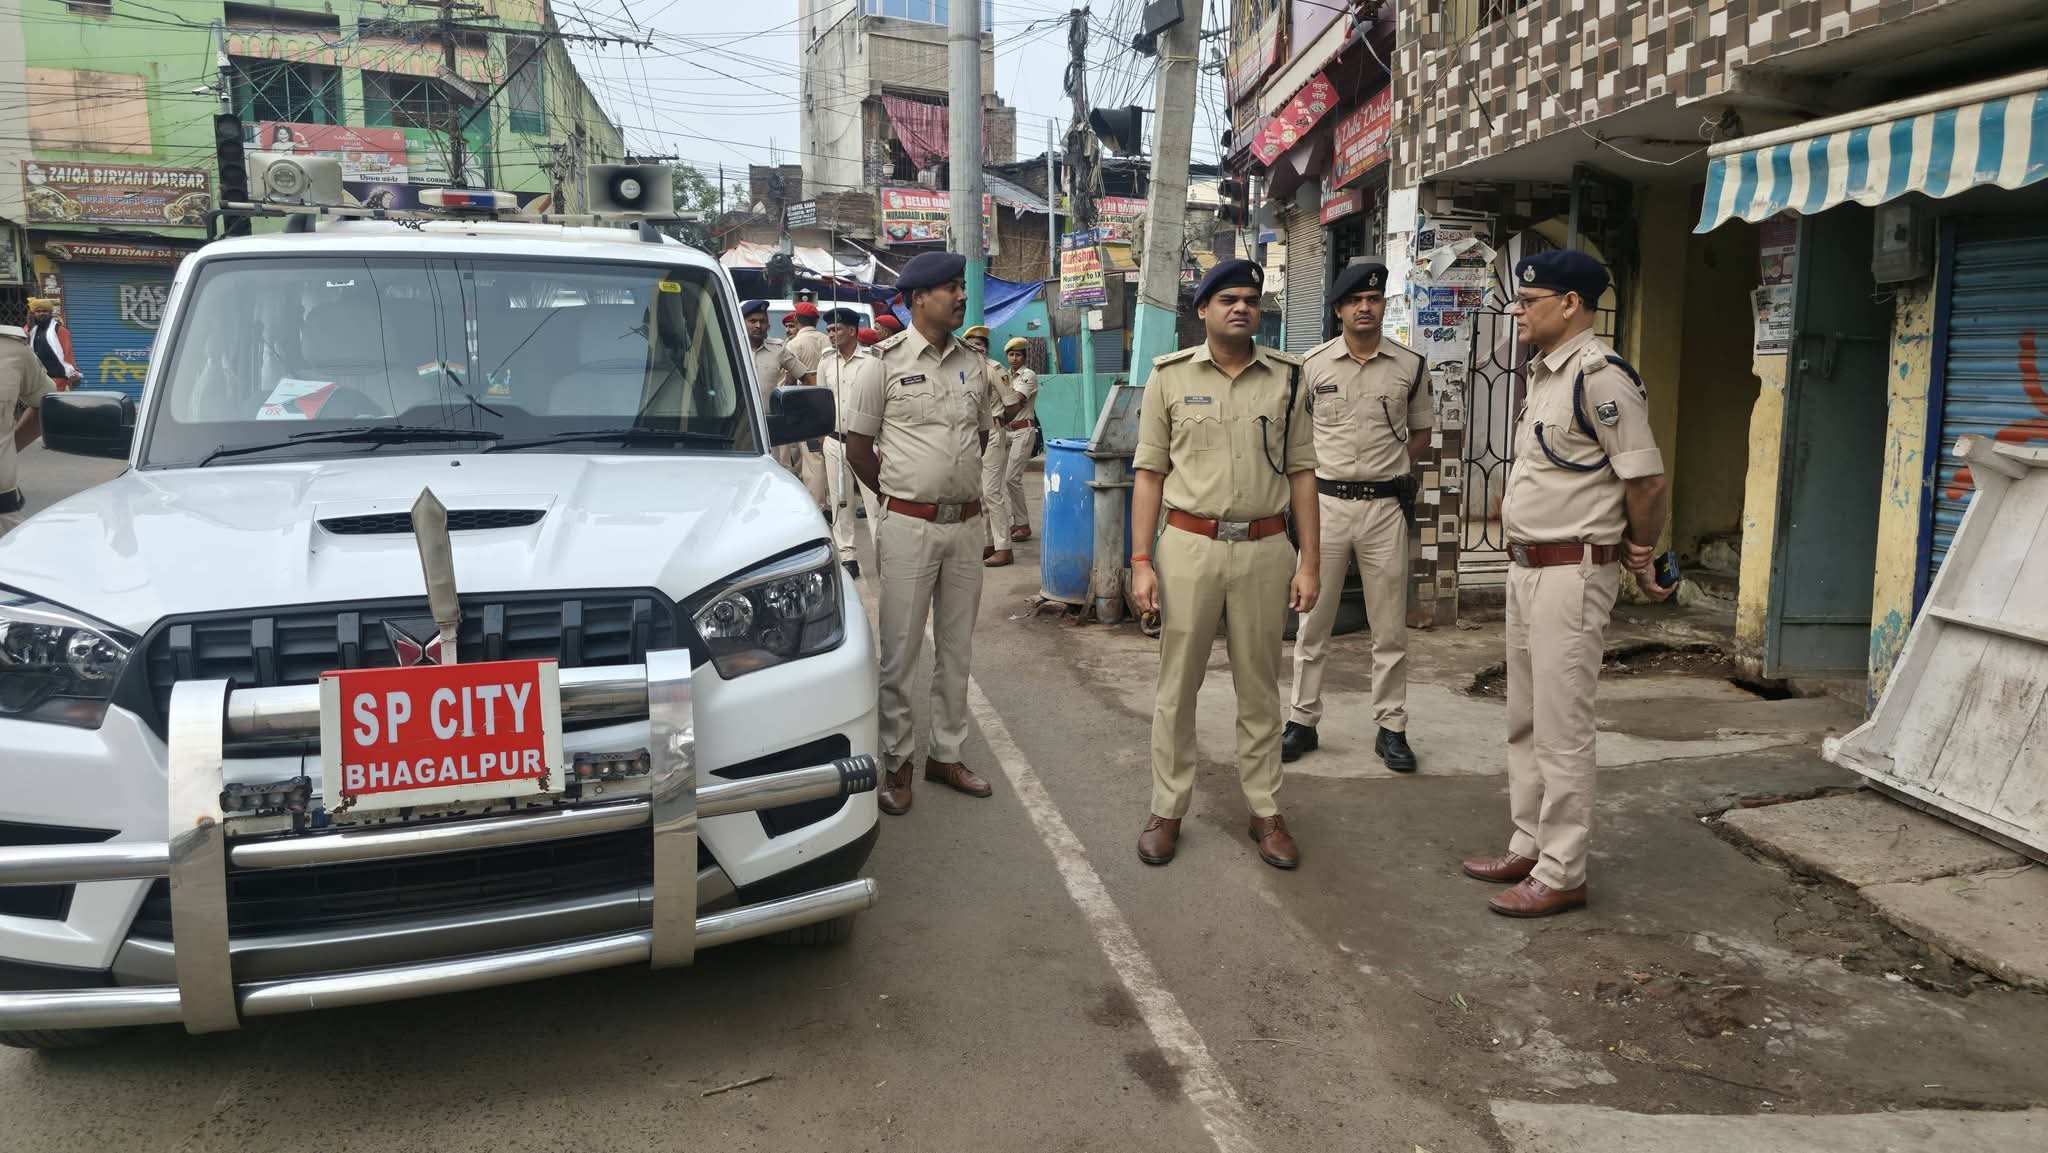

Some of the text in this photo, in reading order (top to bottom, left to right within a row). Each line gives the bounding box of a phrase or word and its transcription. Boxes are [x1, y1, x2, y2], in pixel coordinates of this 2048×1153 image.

[49, 166, 205, 189] ZAIQA BIRYANI DARBAR
[72, 246, 107, 256] ZAIQA
[109, 247, 155, 258] BIRYANI
[1087, 271, 1094, 280] to
[352, 682, 532, 746] SP CITY
[345, 749, 542, 790] BHAGALPUR
